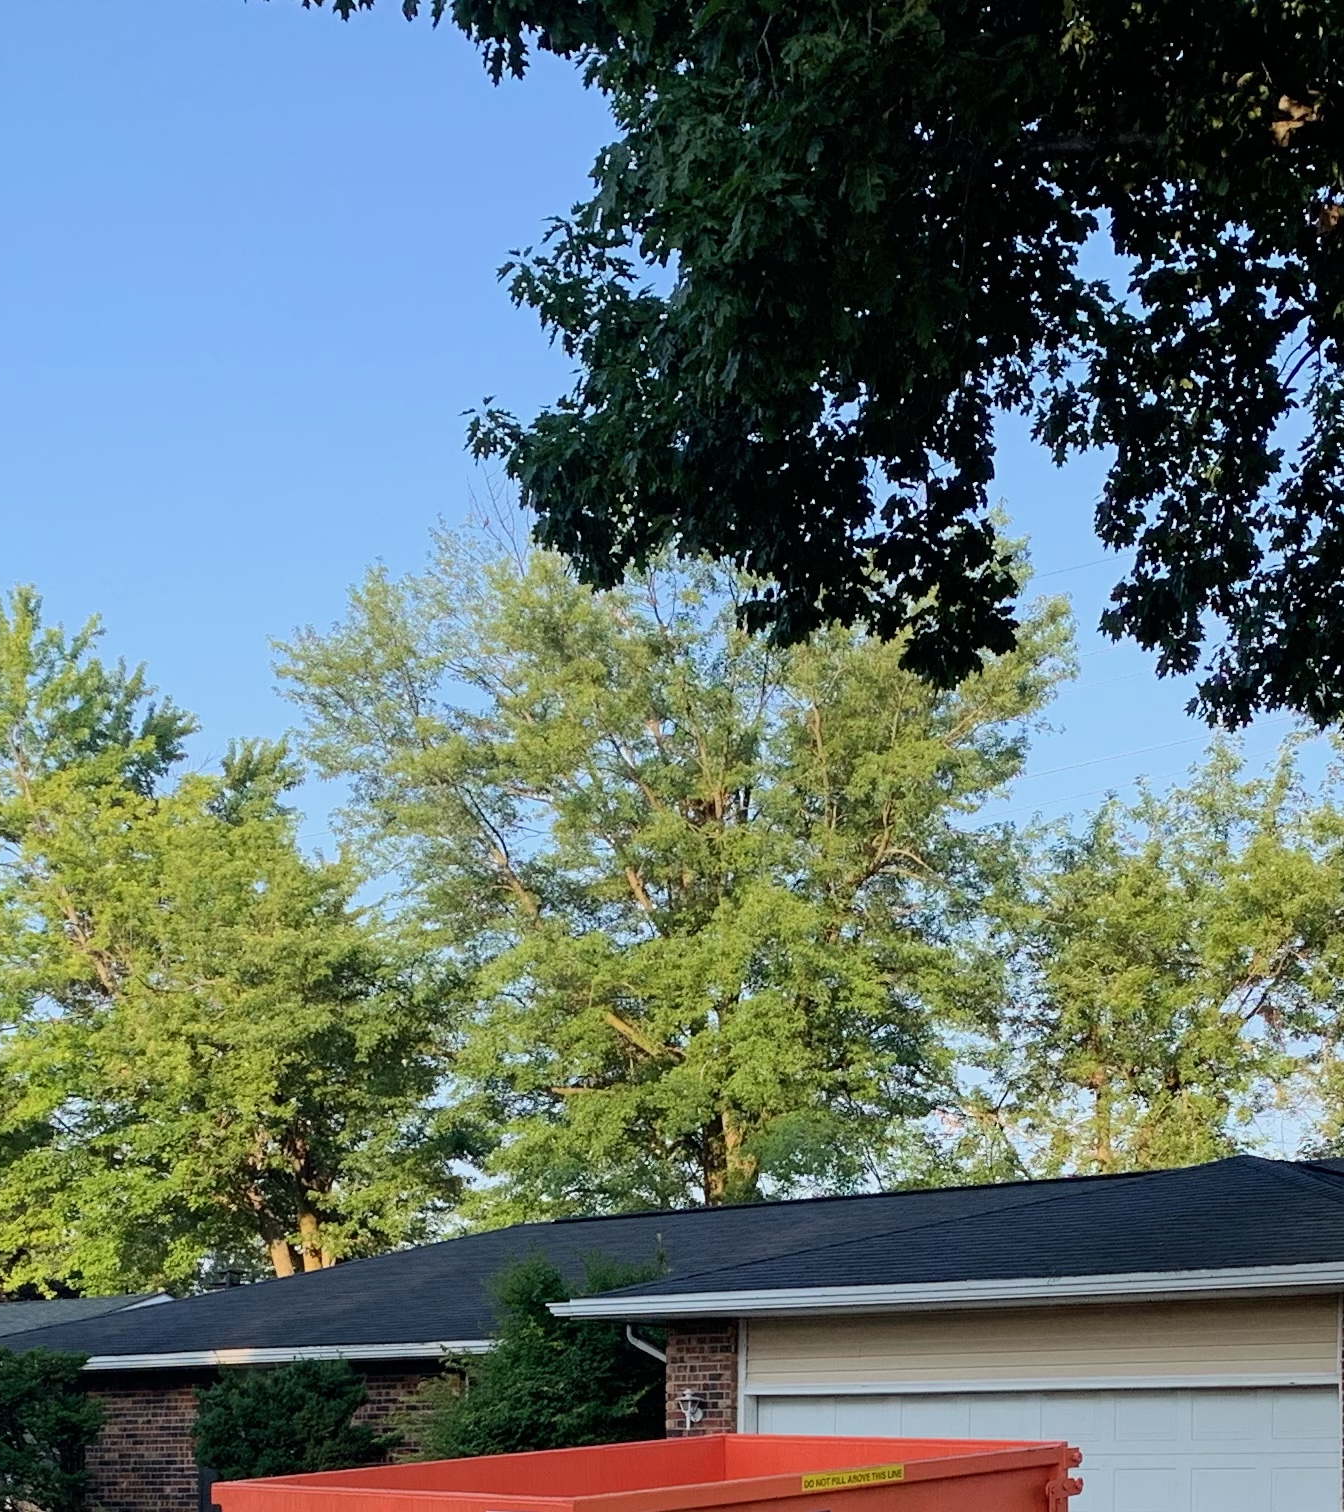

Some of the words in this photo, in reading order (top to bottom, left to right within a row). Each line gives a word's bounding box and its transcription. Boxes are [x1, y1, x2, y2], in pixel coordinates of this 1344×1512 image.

[803, 1479, 814, 1488] DO
[816, 1477, 830, 1487] NOT
[831, 1476, 846, 1485] FILL
[847, 1472, 870, 1483] ABOVE
[872, 1471, 886, 1480] THIS
[887, 1468, 902, 1478] LINE
